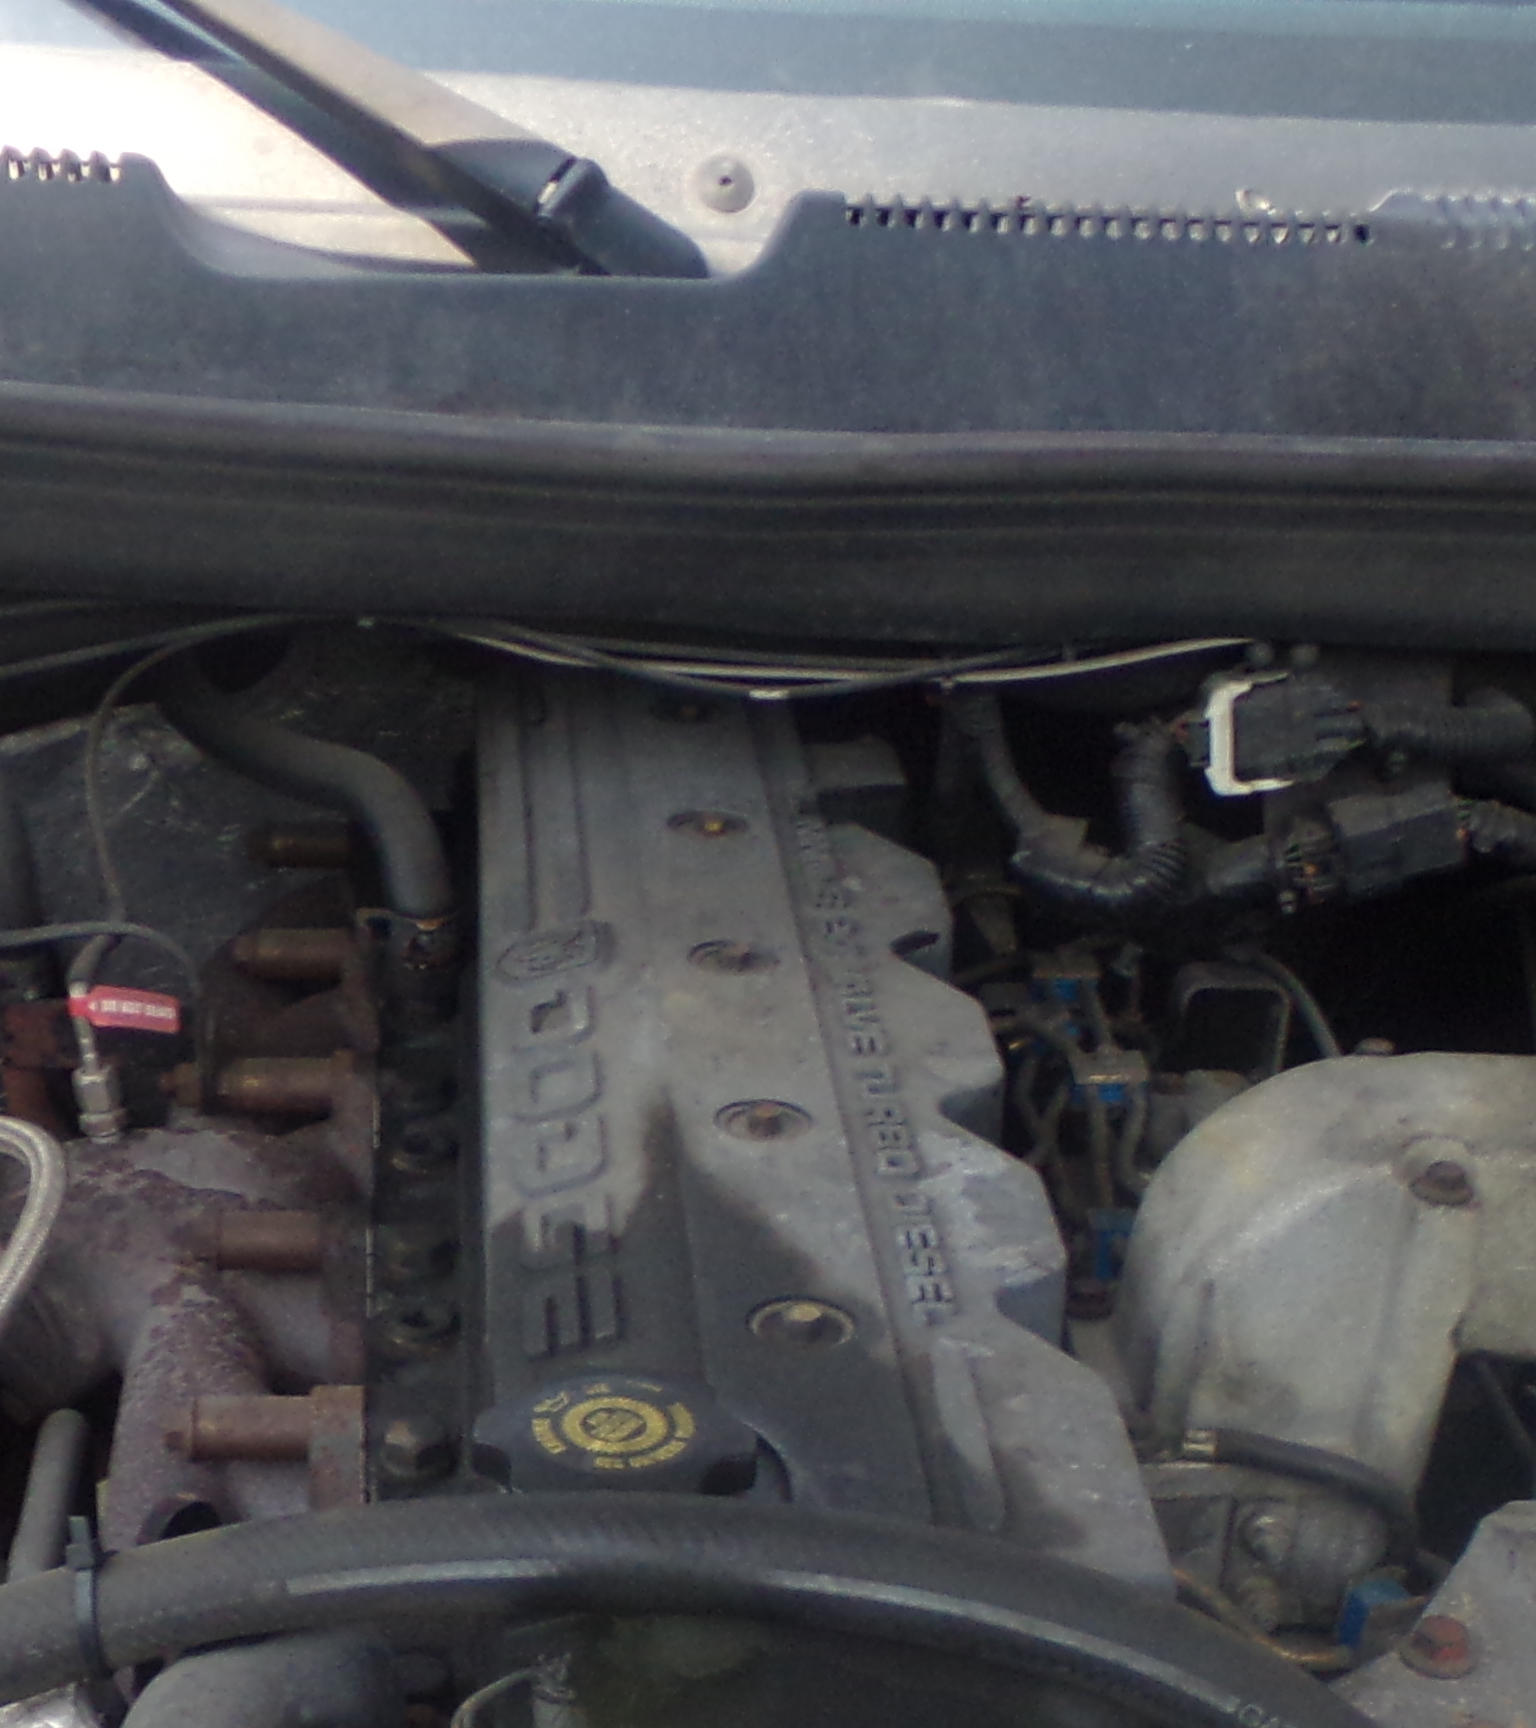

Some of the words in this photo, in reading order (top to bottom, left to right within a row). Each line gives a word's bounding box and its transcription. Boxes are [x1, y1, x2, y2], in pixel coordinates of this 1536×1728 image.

[510, 985, 626, 1358] DODGE
[854, 1064, 920, 1177] TURBO
[892, 1191, 960, 1328] DIESEL
